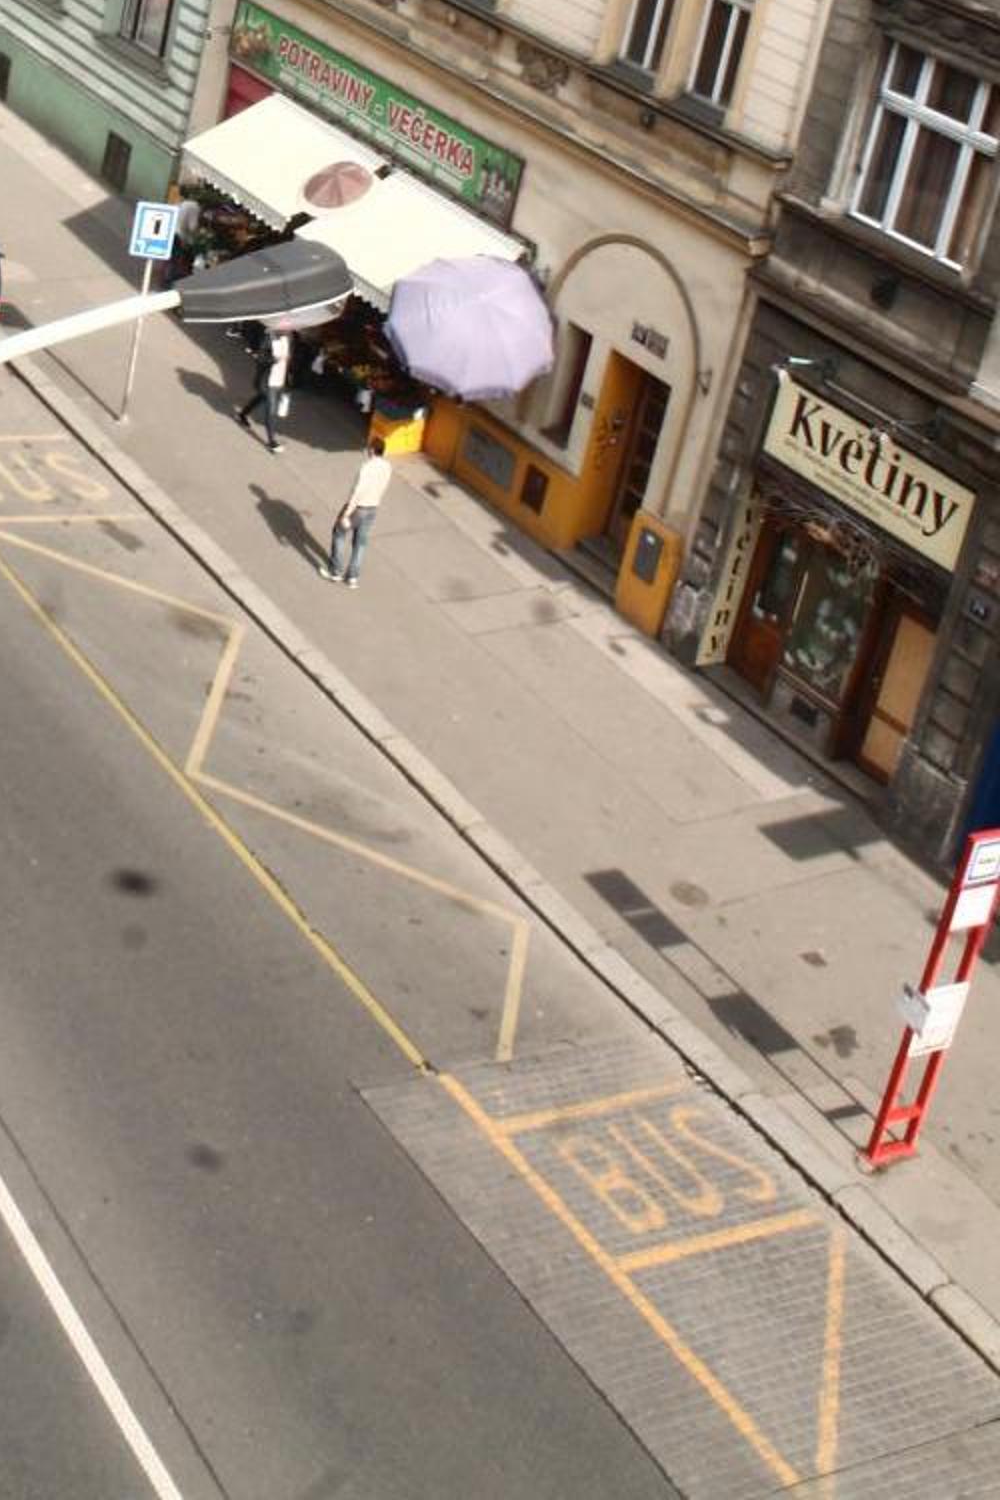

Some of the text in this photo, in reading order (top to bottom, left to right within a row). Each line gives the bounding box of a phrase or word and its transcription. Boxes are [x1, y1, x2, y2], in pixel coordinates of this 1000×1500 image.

[278, 36, 374, 111] POTRAVINY
[388, 101, 474, 176] VEČERKA
[788, 393, 960, 537] Květiny
[554, 1105, 778, 1236] BUS
